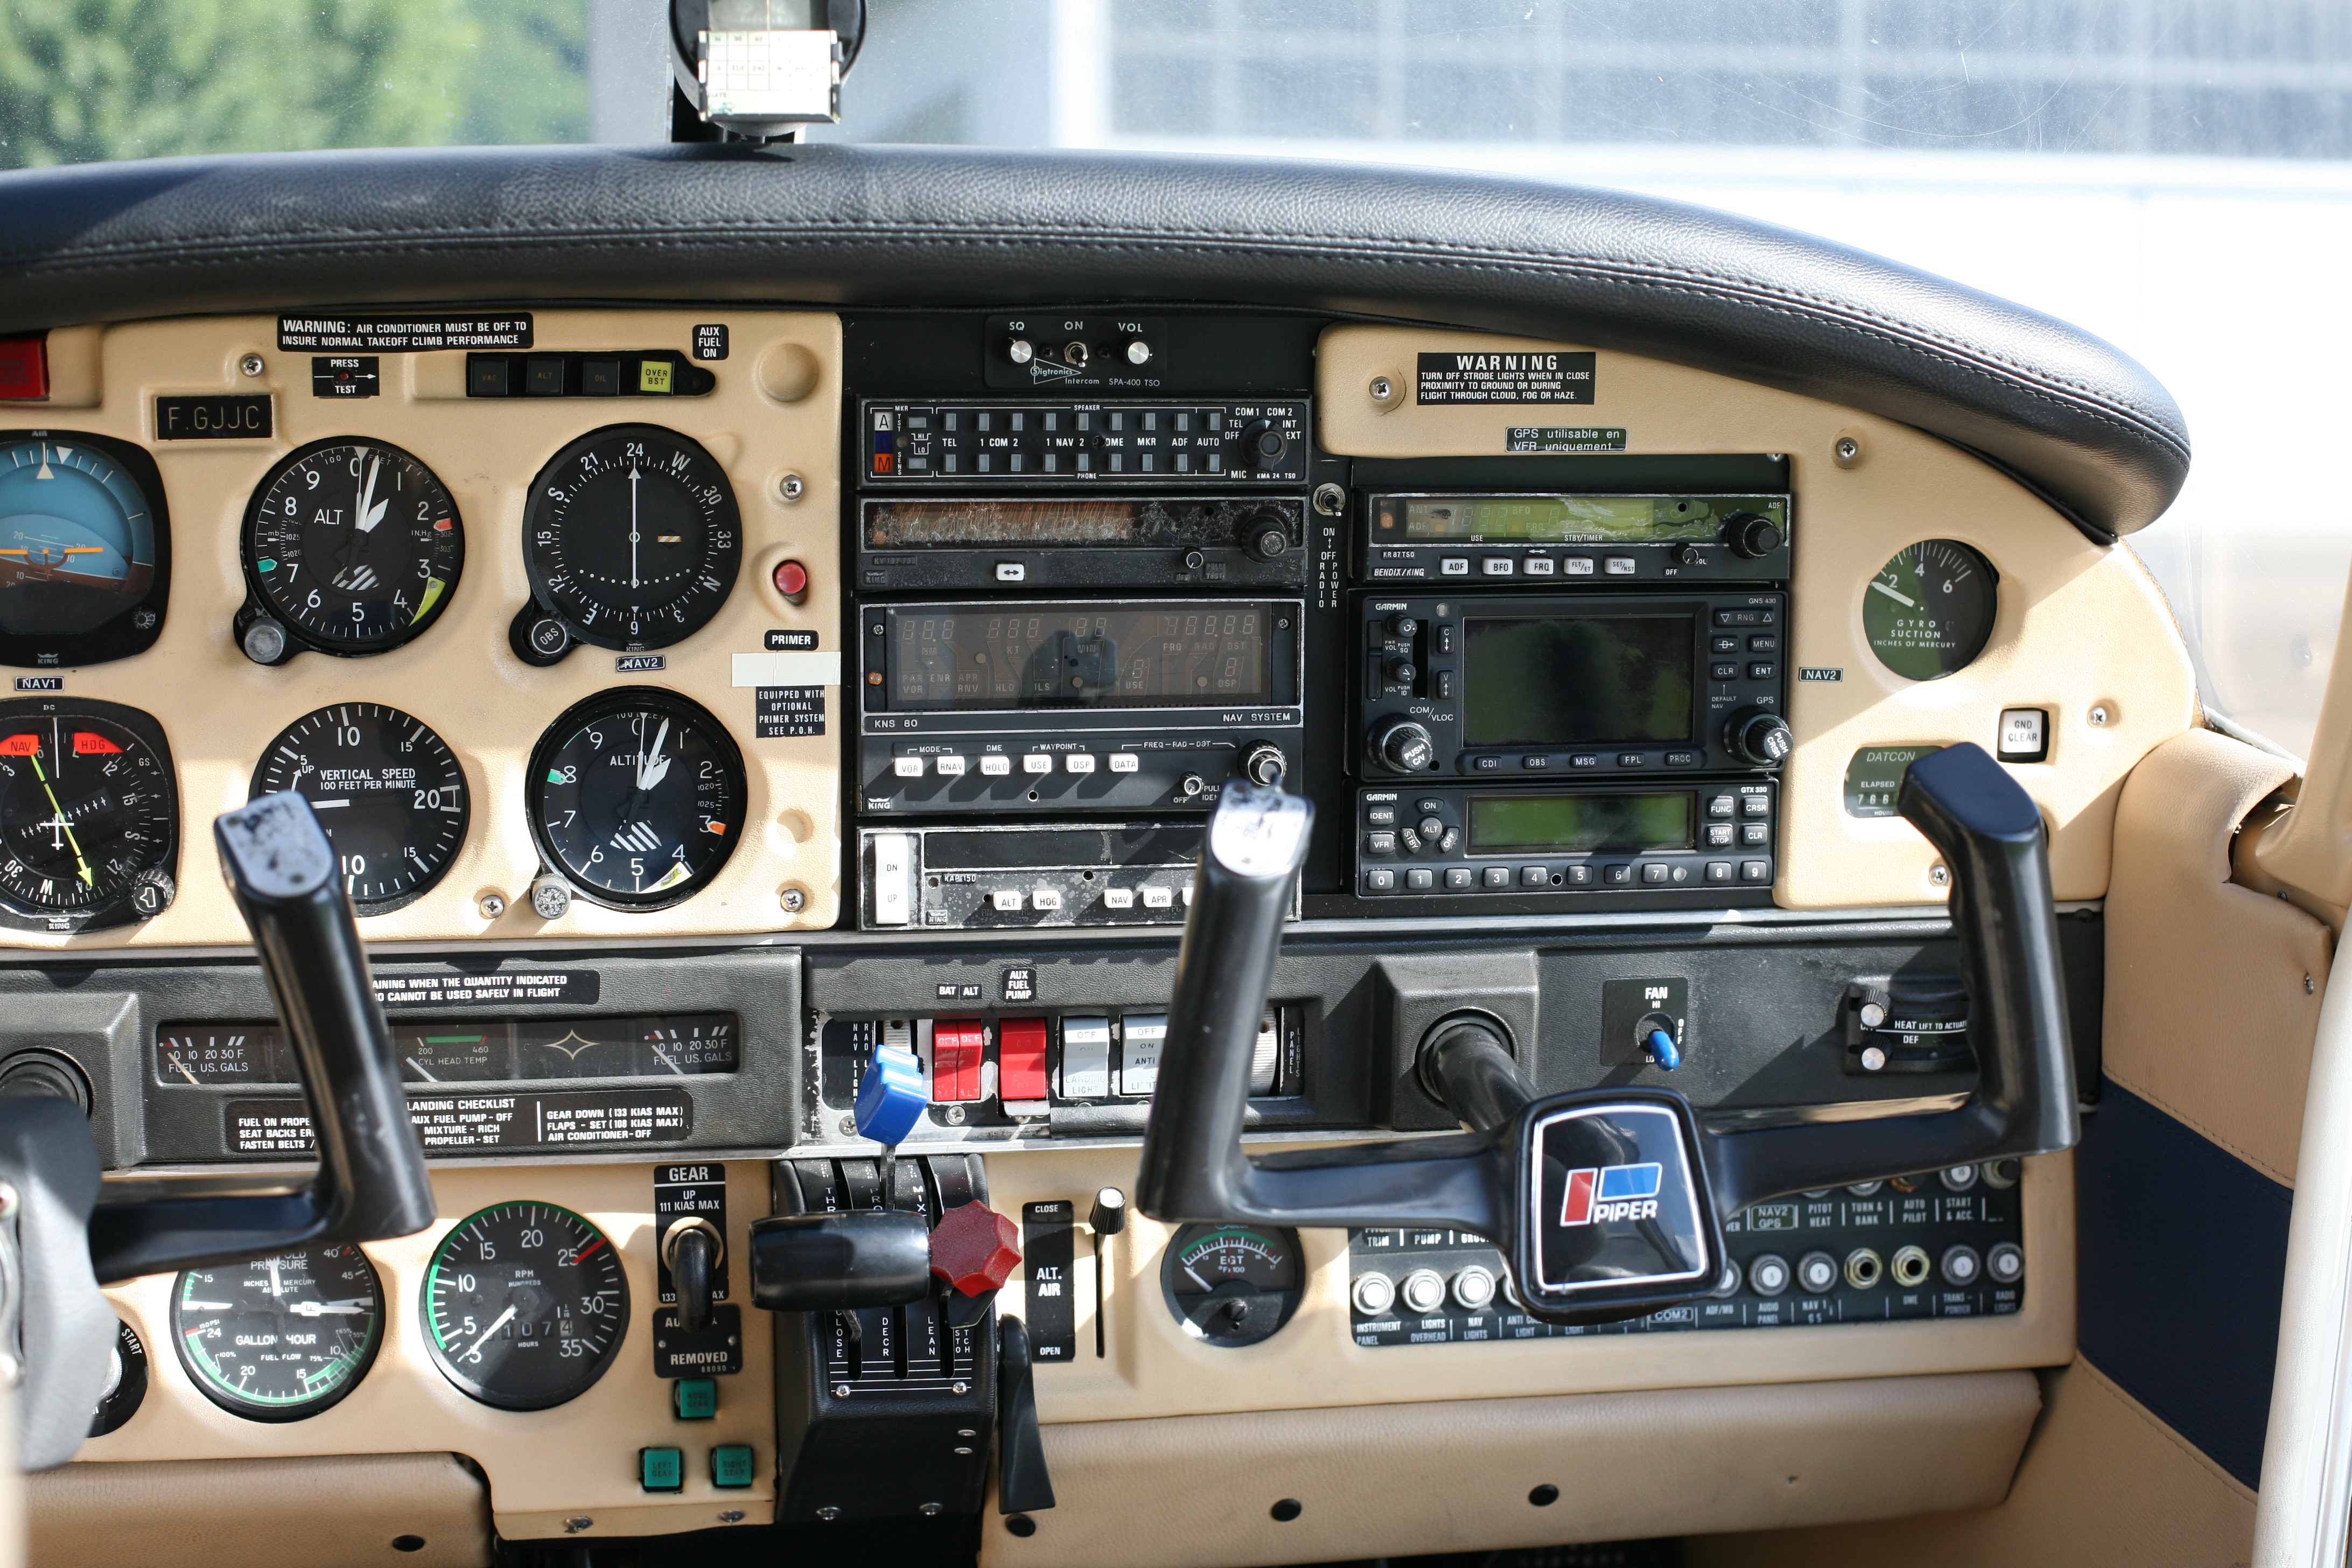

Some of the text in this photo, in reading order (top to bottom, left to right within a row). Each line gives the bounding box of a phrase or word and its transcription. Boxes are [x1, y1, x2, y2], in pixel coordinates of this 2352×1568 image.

[282, 319, 527, 333] WARNING: AIR CONDITIONER MUST BE OFF TO
[1009, 322, 1025, 331] SQ
[1117, 322, 1143, 332] VOL
[699, 327, 719, 337] AUX
[282, 334, 519, 347] INSURE NORMAL TAKEOFF CLIMB PERFORMANCE
[698, 337, 721, 347] FUEL
[703, 348, 717, 358] ON
[330, 359, 359, 368] PRESS
[1456, 355, 1557, 371] WARNING
[646, 368, 668, 377] OVER
[1030, 366, 1073, 376] Sigtronics
[1421, 372, 1590, 380] TURN OFF STROBE LIGHTS WHEN IN CLOSE
[1109, 378, 1160, 387] SPA-400 TSO
[1420, 381, 1561, 390] PROXIMITY TO GROUND OR DURING
[334, 385, 356, 394] TEST
[1420, 391, 1577, 401] FLIGHT THROUGH CLOUD, FOG OR HAZE.
[1514, 429, 1620, 439] GPS utilisable en
[942, 438, 957, 447] TEL
[980, 438, 1018, 447] 1 COM 2
[1046, 438, 1084, 447] 1 NAV 2
[1137, 437, 1156, 446] MKR
[1171, 438, 1188, 446] ADF
[1196, 438, 1220, 446] AUTO
[1513, 442, 1613, 452] VFR uniquement
[1230, 470, 1247, 479] MIC
[313, 509, 344, 526] ALT
[411, 529, 432, 538] IN.Hg
[1322, 527, 1335, 536] ON
[1564, 534, 1603, 542] STBY/TIMER
[1320, 551, 1336, 560] OFF
[1448, 562, 1465, 571] ADF
[1493, 563, 1509, 572] BFO
[1373, 567, 1425, 577] BENDIX/KING
[1375, 603, 1408, 611] GARMIN
[1896, 619, 1936, 628] GYRO
[1890, 629, 1941, 639] SUCTION
[771, 635, 811, 646] PRIMER
[1753, 640, 1775, 648] MENU
[624, 658, 659, 669] NAV2
[1717, 667, 1734, 675] CLR
[1755, 667, 1772, 675] ENT
[1805, 670, 1837, 681] NAV2
[22, 678, 57, 689] NAV1
[759, 689, 825, 699] EQUIPPED WITH
[771, 702, 813, 711] OPTIONAL
[759, 713, 825, 724] PRIMER SYSTEM
[1222, 713, 1291, 723] NAV SYSTEM
[874, 719, 918, 729] KNS 80
[2014, 720, 2032, 729] GND
[768, 725, 816, 736] SEE P.O.H.
[2007, 732, 2038, 743] CLEAR
[81, 740, 106, 751] HDG
[1866, 751, 1915, 762] DATCON
[940, 762, 963, 771] RNAV
[1031, 761, 1047, 769] USE
[1481, 759, 1497, 768] CDI
[1529, 758, 1546, 767] OBS
[320, 768, 416, 780] VERTICAL SPEED
[901, 765, 919, 773] VOR
[320, 780, 416, 790] 100 FEET PER MINUTE
[1366, 793, 1398, 801] GARMIN
[1370, 811, 1393, 820] IDENT
[1374, 841, 1389, 849] VFR
[1001, 898, 1017, 907] ALT
[1039, 898, 1057, 907] HDG
[408, 974, 568, 988] WHEN THE QUANTITY INDICATED
[387, 987, 561, 1002] CANNOT BE USED SAFELY IN FLIGHT
[939, 986, 956, 996] BAT
[1644, 986, 1668, 1000] FAN
[407, 1097, 516, 1112] LANDING CHECKLIST
[546, 1108, 605, 1120] GEAR DOWN
[424, 1124, 466, 1135] MIXTURE
[669, 1167, 709, 1181] GEAR
[659, 1200, 720, 1212] 111 KIAS MAX
[1945, 1197, 1972, 1208] START
[1035, 1204, 1059, 1213] CLOSE
[1593, 1199, 1657, 1223] PIPER
[1902, 1212, 1927, 1223] PILOT
[1414, 1234, 1442, 1245] PUMP
[1220, 1255, 1244, 1265] EGT
[515, 1270, 534, 1278] RPM
[1038, 1283, 1061, 1297] AIR
[121, 1328, 143, 1355] START
[670, 1352, 727, 1366] REMOVED
